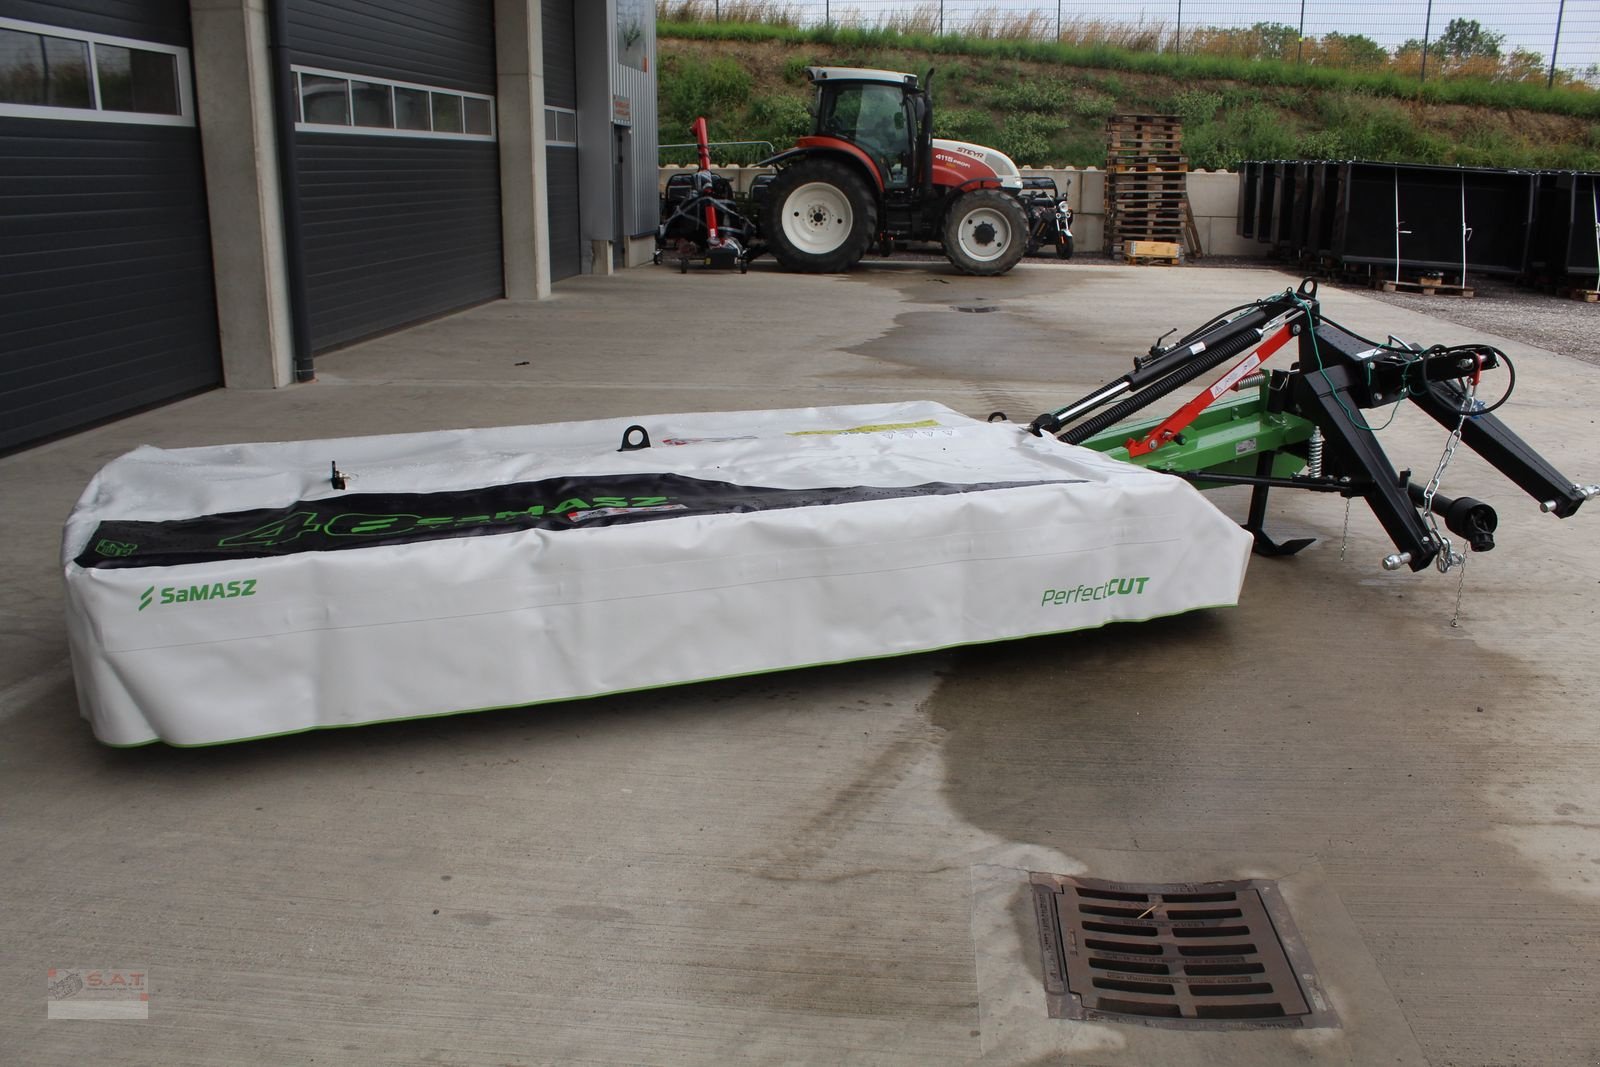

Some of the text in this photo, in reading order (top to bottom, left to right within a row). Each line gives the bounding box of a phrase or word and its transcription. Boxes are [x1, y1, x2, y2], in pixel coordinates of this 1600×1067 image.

[935, 154, 953, 163] 4115
[956, 147, 984, 158] STEYR
[160, 579, 257, 604] SaMASZ
[1041, 577, 1150, 607] PerfectCUT
